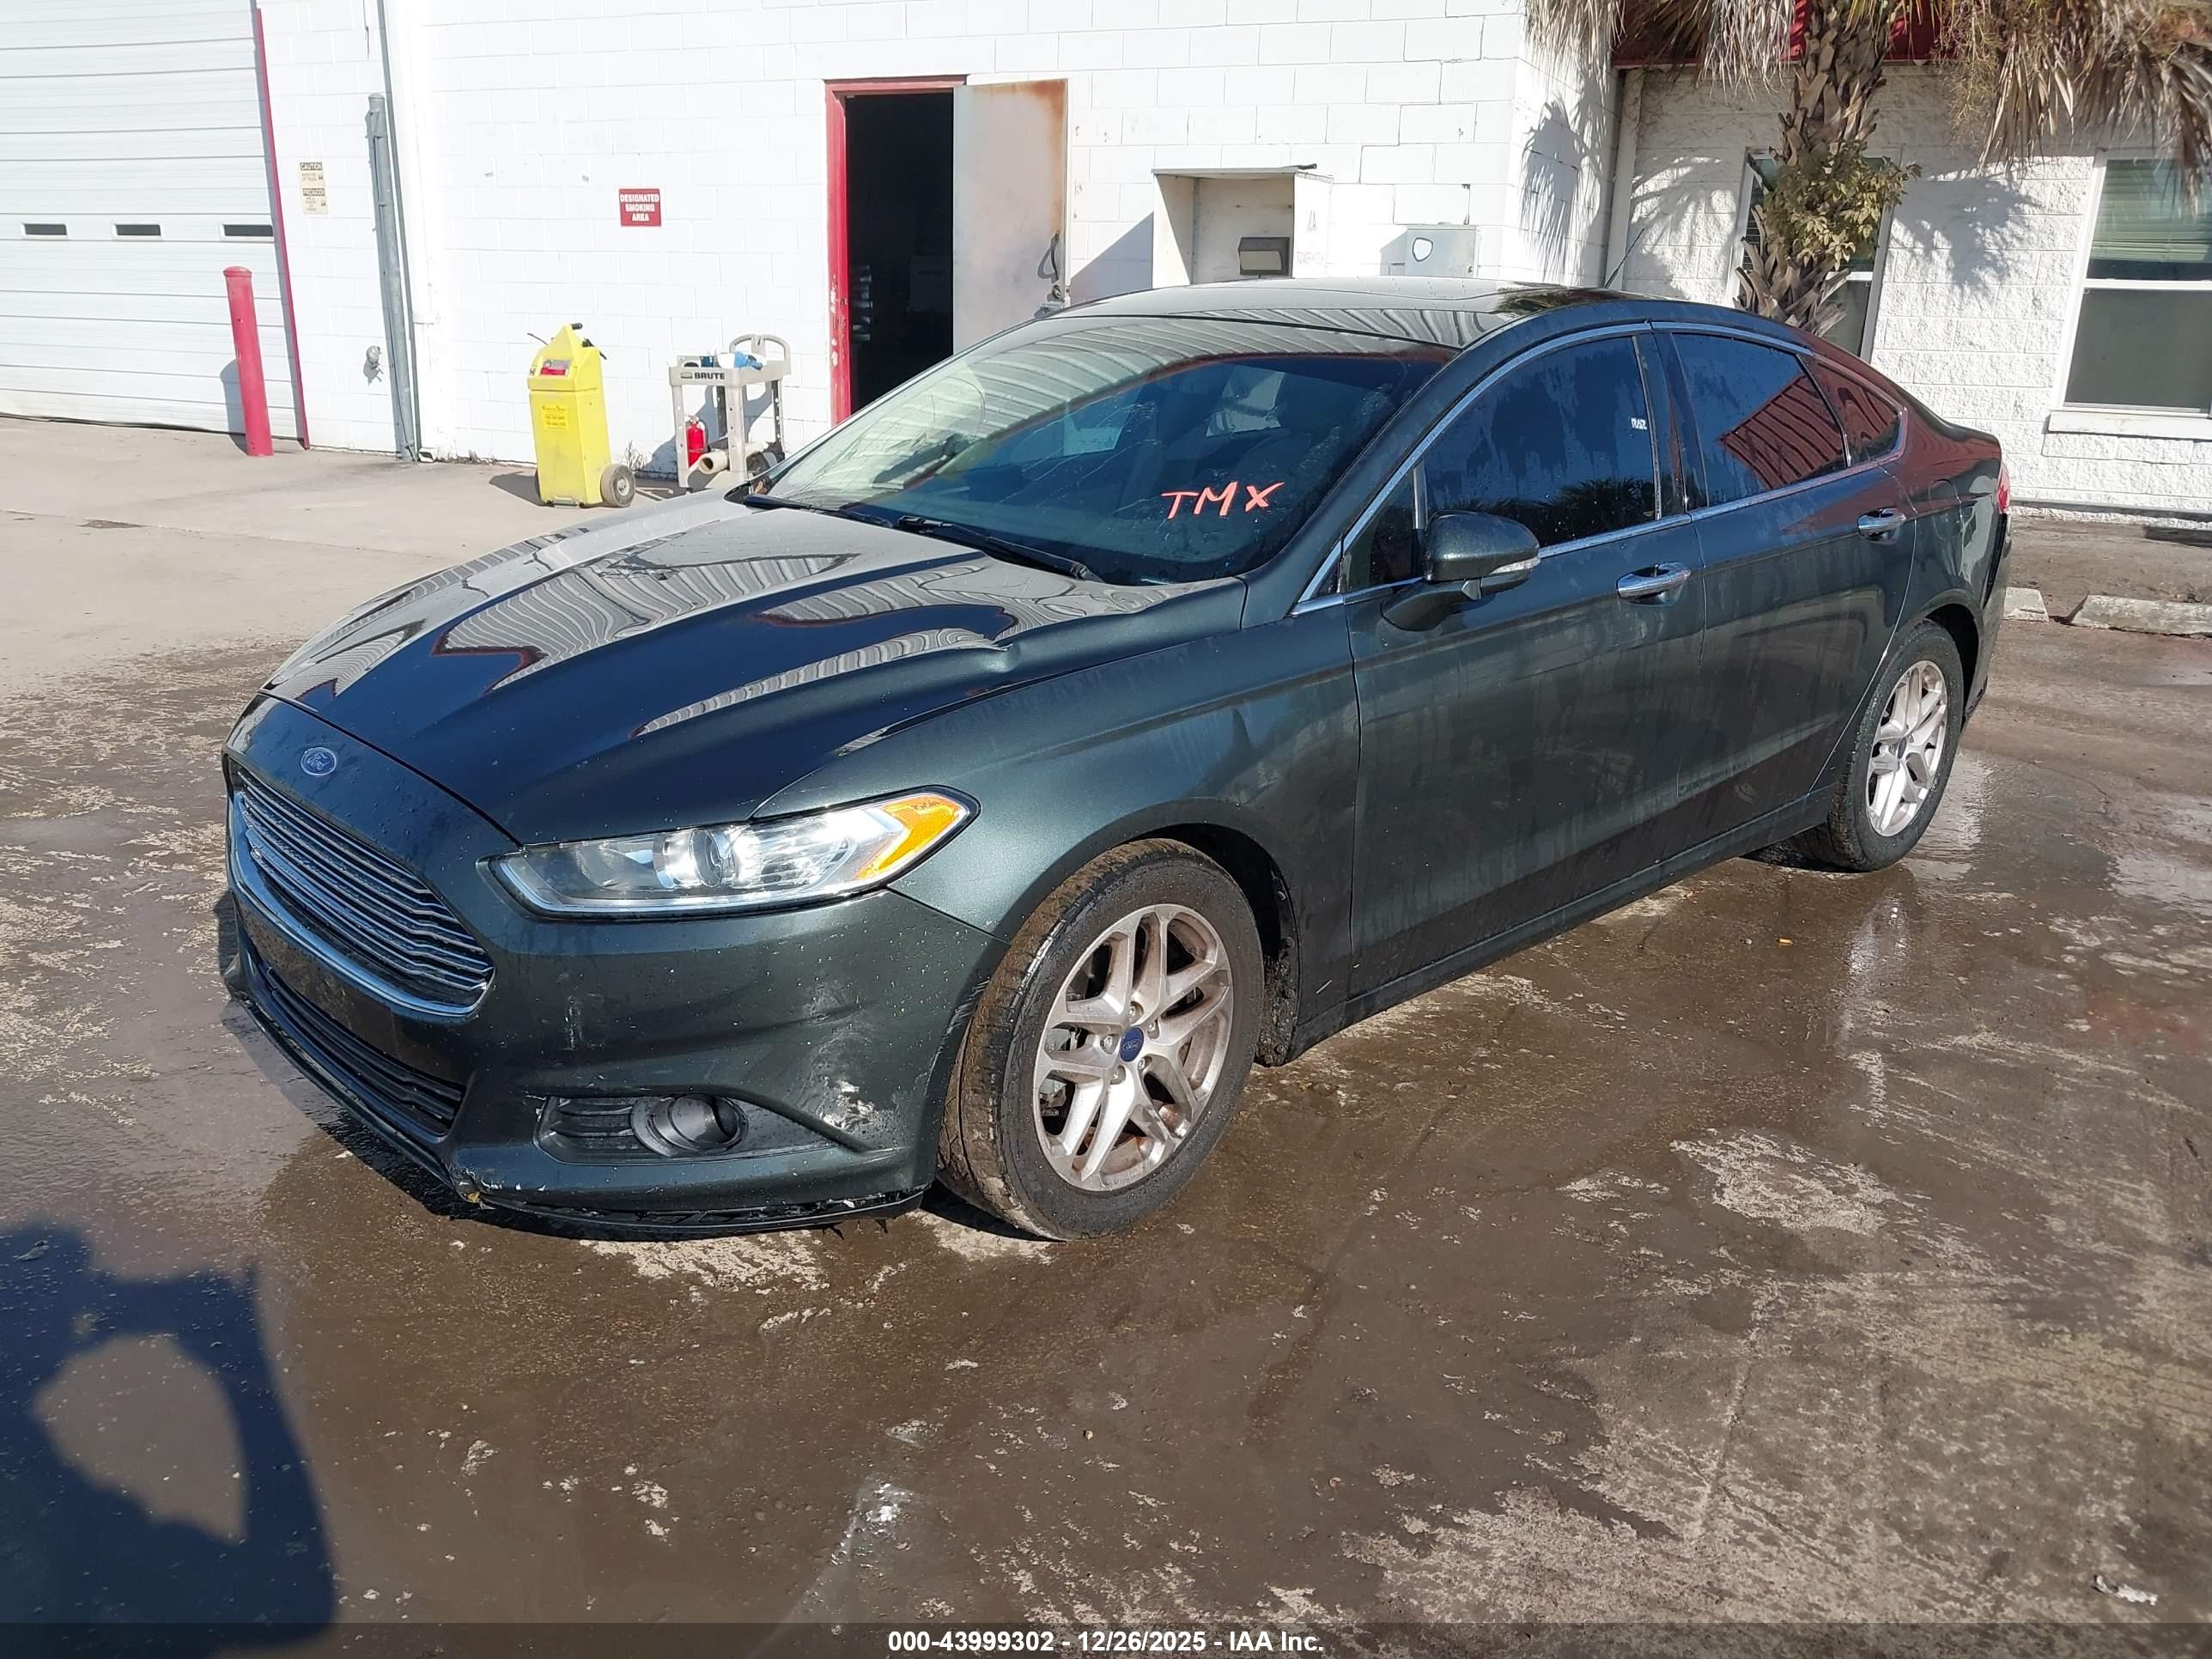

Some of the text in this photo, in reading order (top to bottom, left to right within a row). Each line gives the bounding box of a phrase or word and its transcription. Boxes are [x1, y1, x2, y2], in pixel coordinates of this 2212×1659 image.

[620, 194, 659, 203] DESIGNATED
[625, 204, 655, 212] SMOKING
[632, 213, 649, 222] AREA
[1161, 481, 1285, 520] TMX
